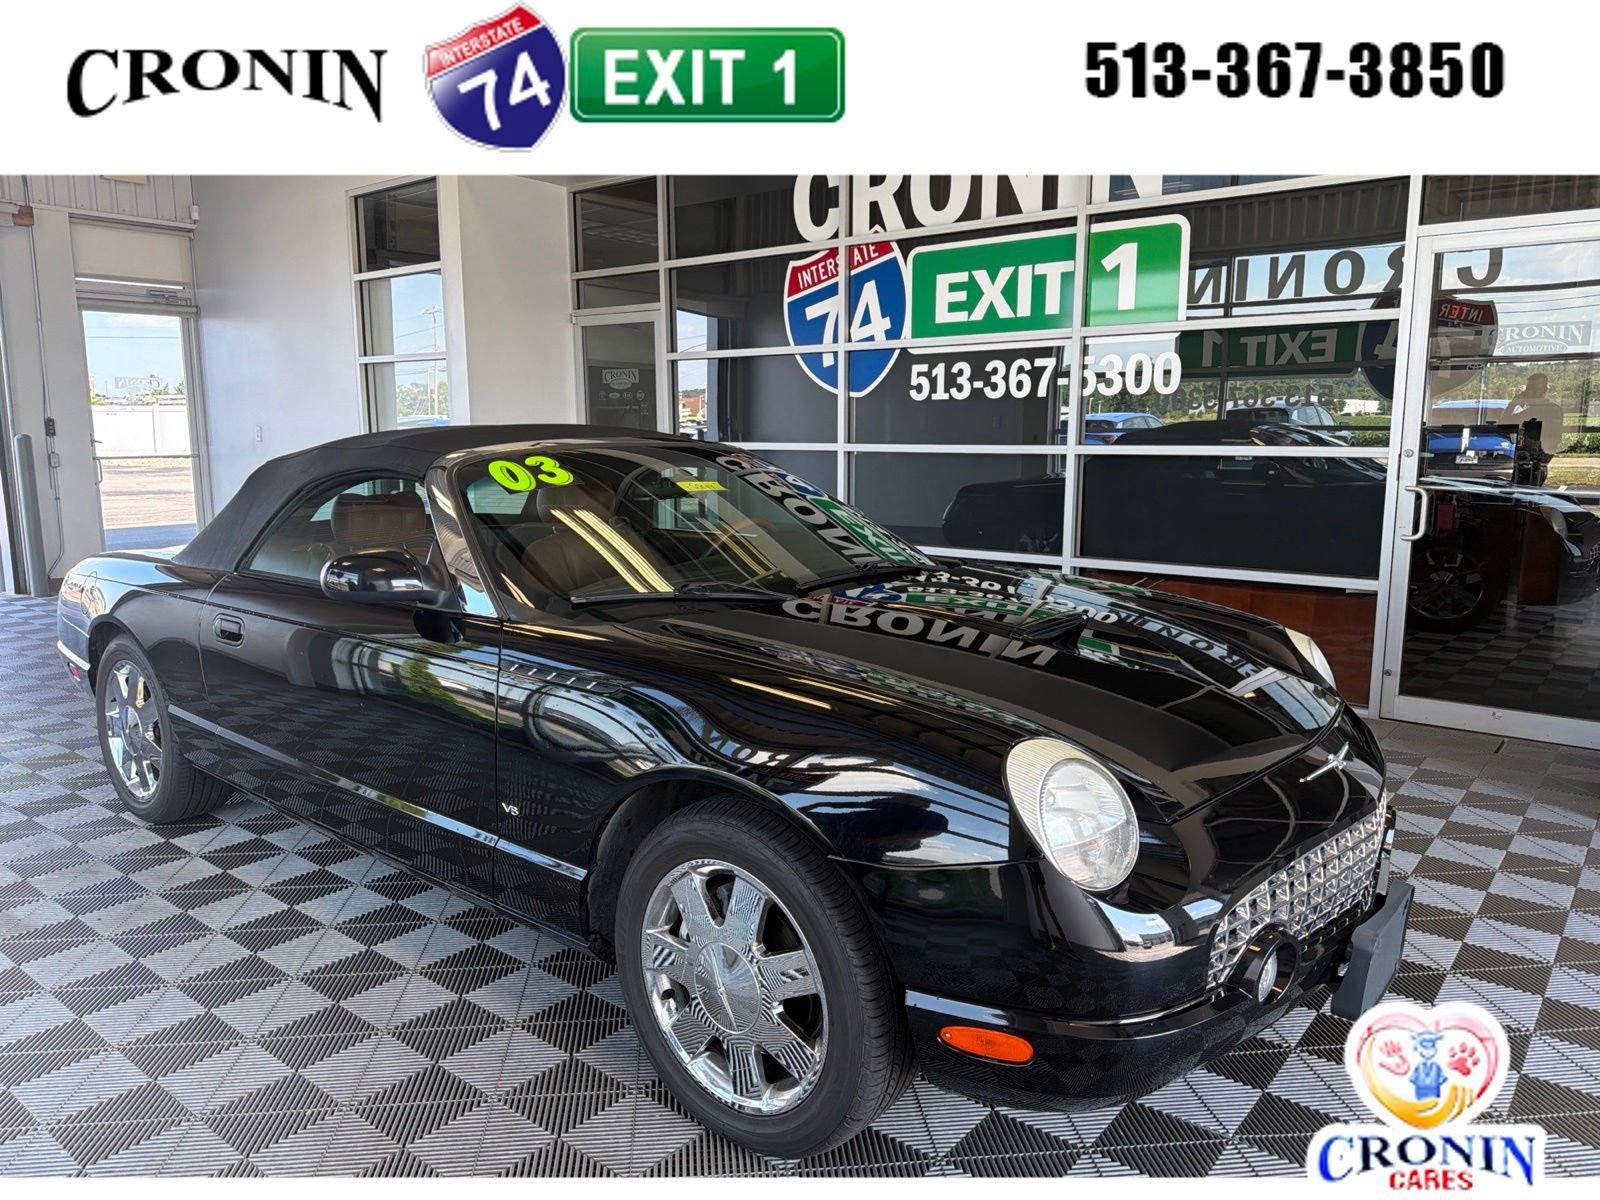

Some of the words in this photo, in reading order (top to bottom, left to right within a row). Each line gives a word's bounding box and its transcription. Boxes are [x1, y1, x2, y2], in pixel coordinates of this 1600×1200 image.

[793, 174, 1163, 242] CRONIN
[798, 243, 879, 290] INTERATE
[934, 260, 1075, 324] EXIT
[1101, 242, 1139, 312] 1
[804, 279, 892, 369] 74
[488, 455, 574, 492] 03
[502, 802, 519, 816] V8
